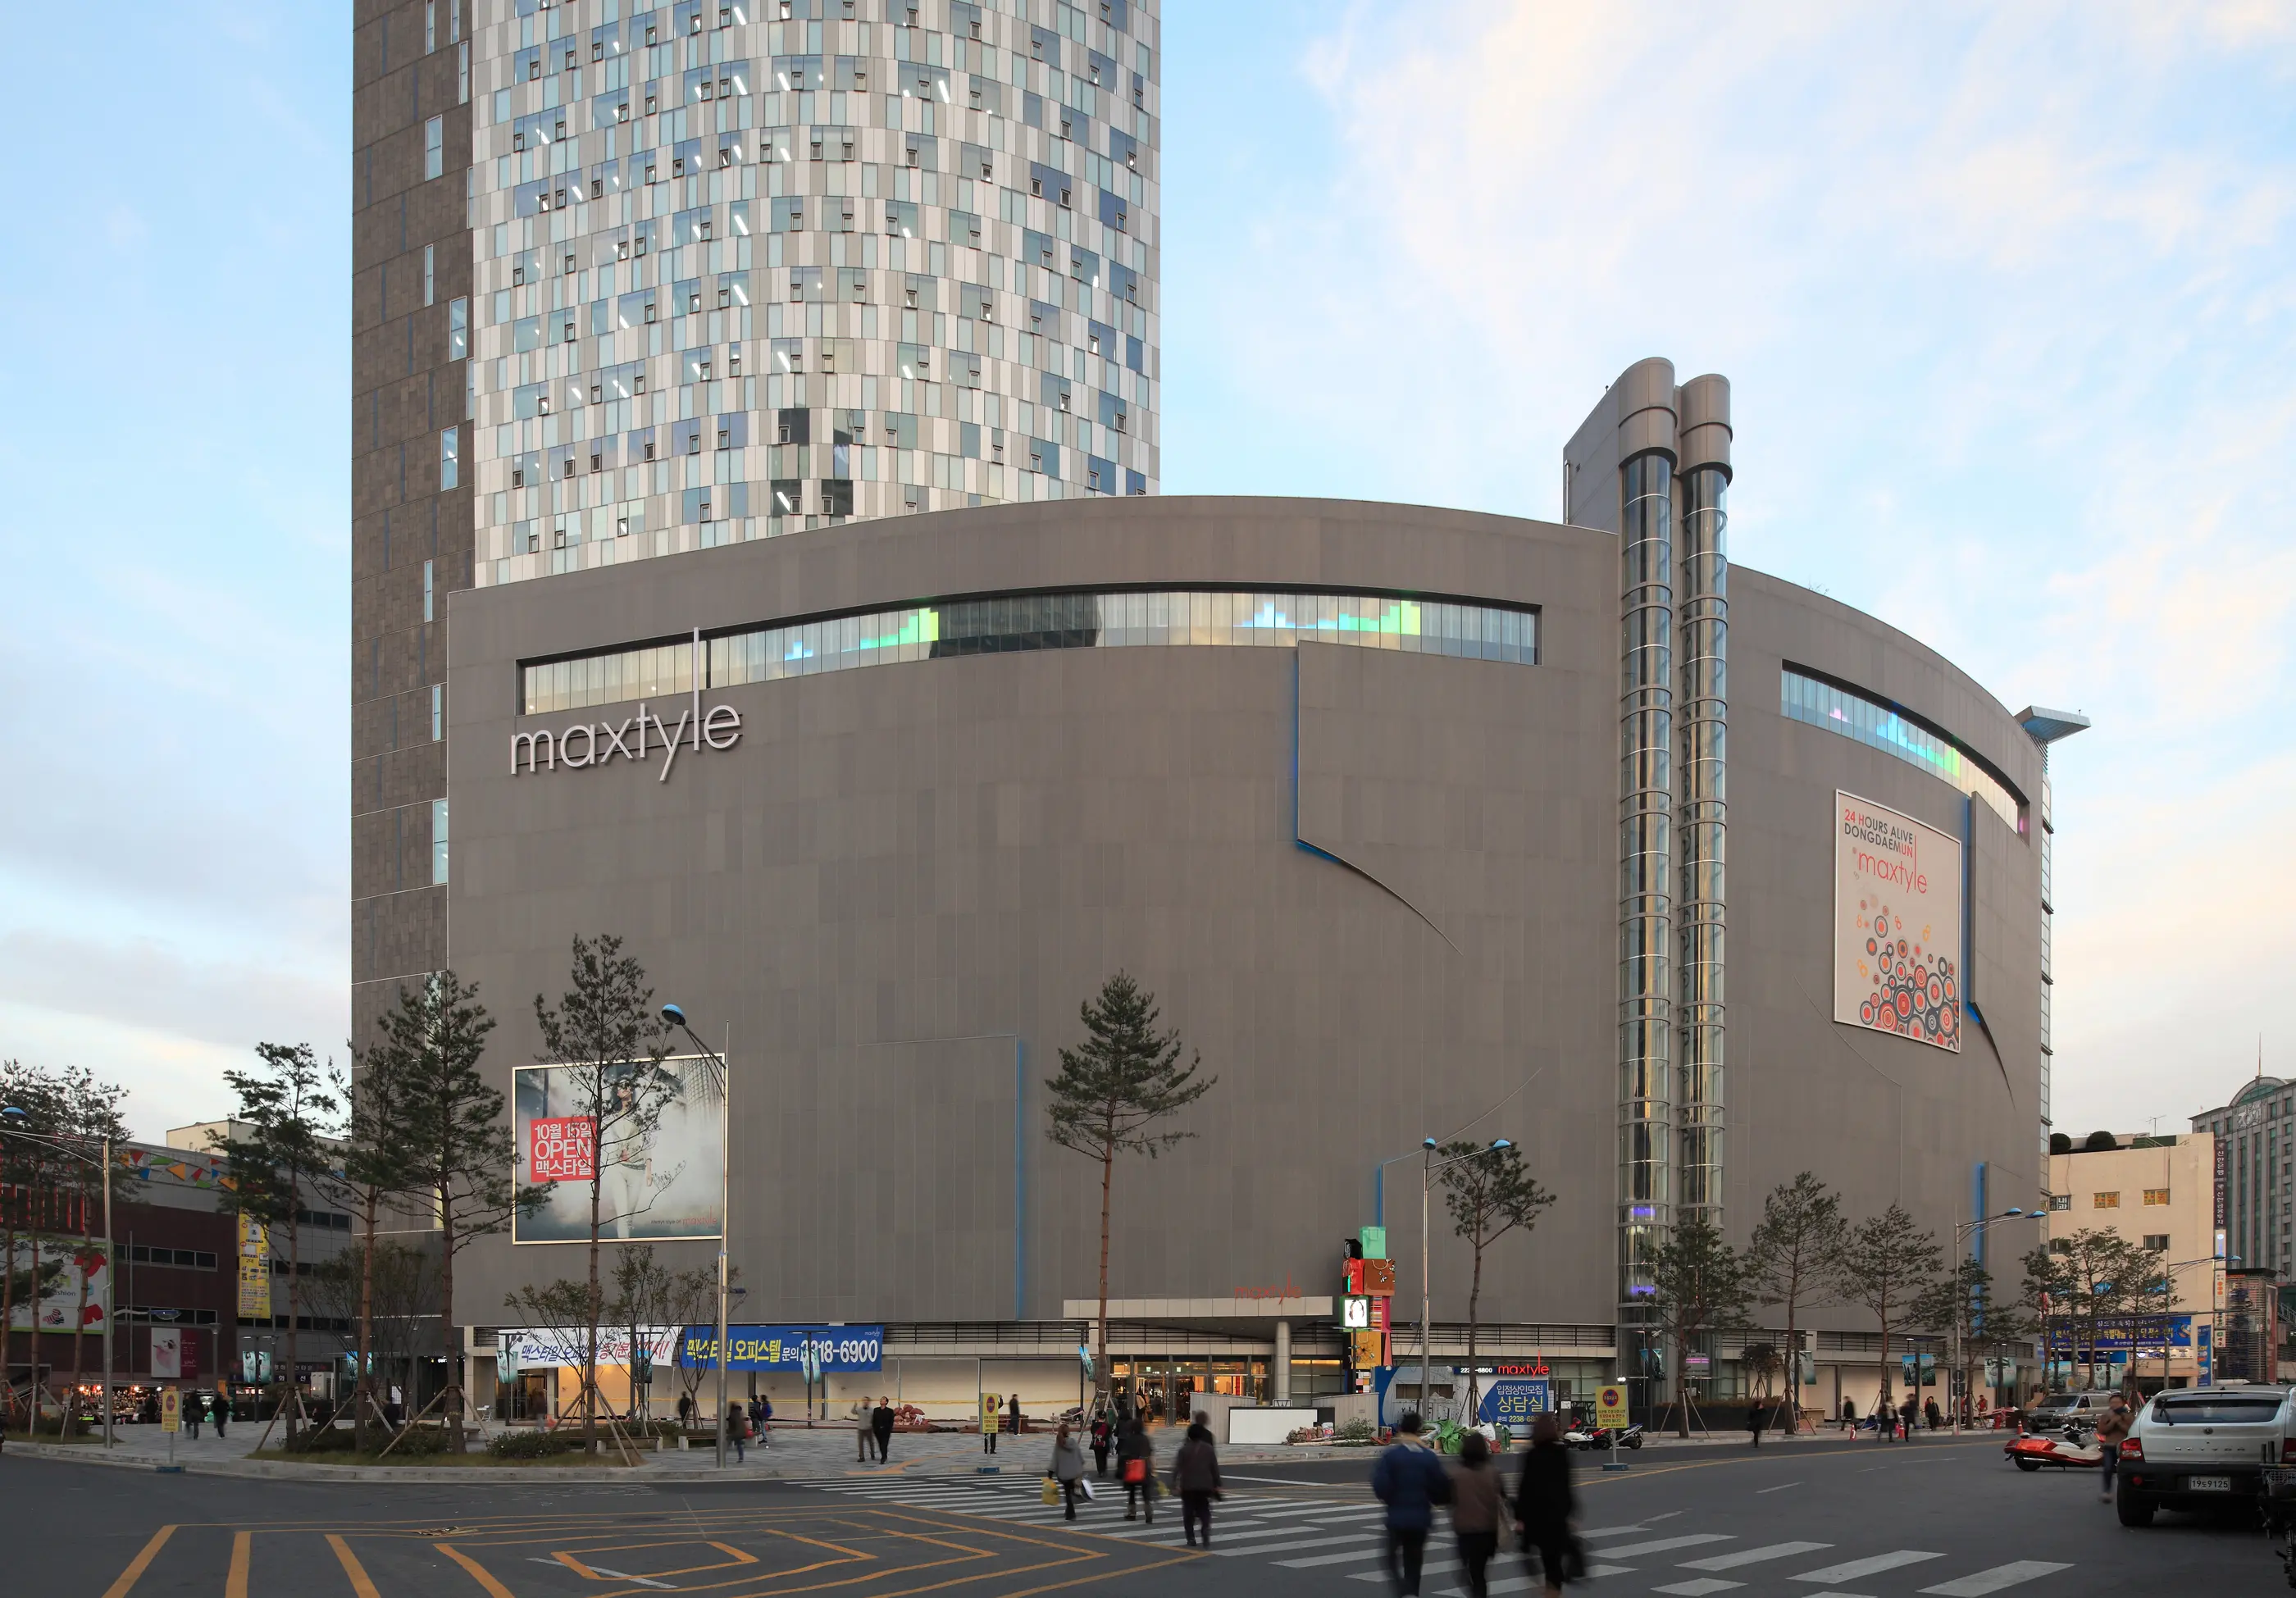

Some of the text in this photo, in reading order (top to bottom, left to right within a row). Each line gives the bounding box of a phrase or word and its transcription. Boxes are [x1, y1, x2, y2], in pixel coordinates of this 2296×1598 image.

[511, 627, 741, 781] maxtyle
[1844, 808, 1913, 845] 24 HOURS ALIVE
[1844, 822, 1913, 858] DONGDAEMUN
[1858, 835, 1927, 894] maxtyle
[535, 1123, 562, 1140] 10월
[535, 1138, 592, 1160] OPEN
[535, 1159, 592, 1177] 맥스타일
[682, 1205, 718, 1226] maxtyle
[1234, 1268, 1302, 1305] maxtyle
[734, 1339, 781, 1363] 오피스텔
[782, 1346, 800, 1362] 문의
[1497, 1350, 1550, 1378] maxtyle
[1496, 1385, 1543, 1395] 입점상인모집
[1496, 1395, 1543, 1413] 상담실
